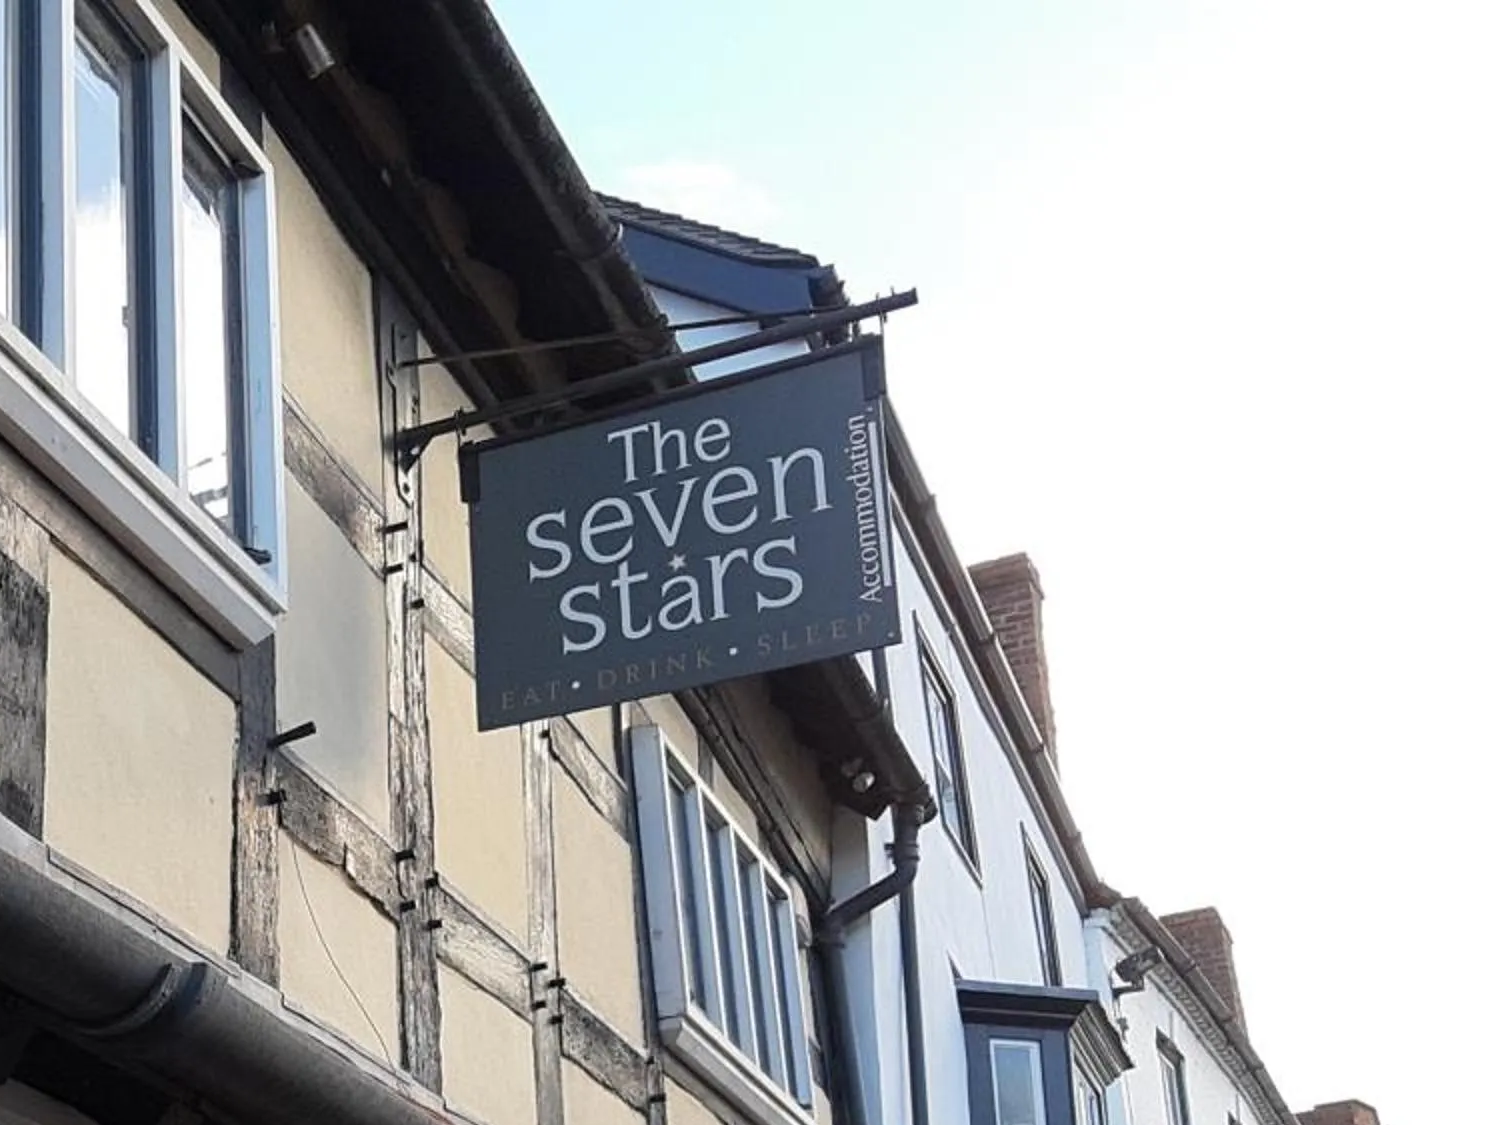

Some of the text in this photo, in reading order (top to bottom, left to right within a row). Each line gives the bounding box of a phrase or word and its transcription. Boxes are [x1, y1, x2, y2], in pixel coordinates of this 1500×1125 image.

[607, 417, 731, 483] The
[846, 415, 882, 603] Accommodation
[525, 445, 833, 583] seven
[559, 536, 804, 655] stars
[501, 611, 873, 711] EAT DRINK SLEEP
